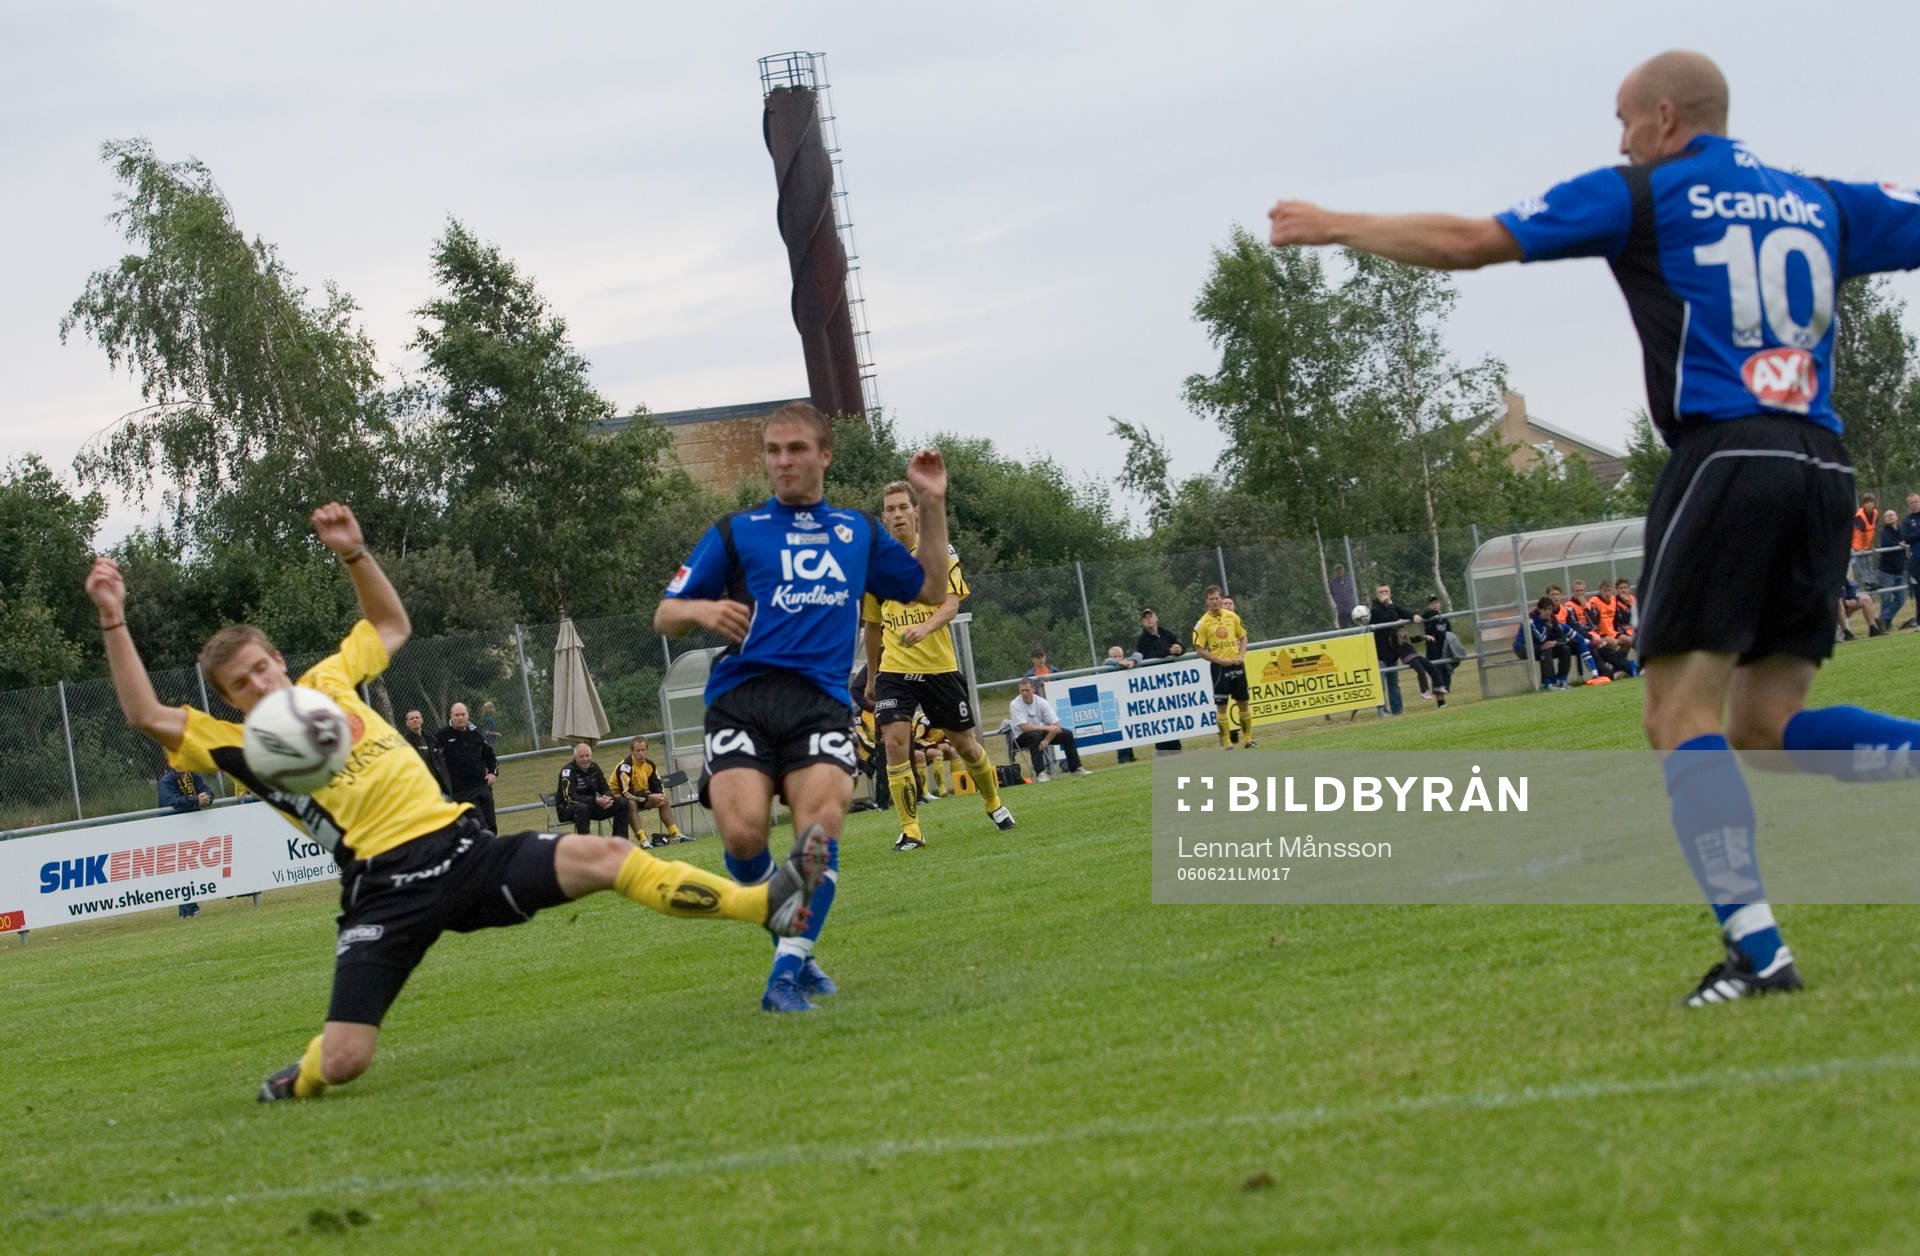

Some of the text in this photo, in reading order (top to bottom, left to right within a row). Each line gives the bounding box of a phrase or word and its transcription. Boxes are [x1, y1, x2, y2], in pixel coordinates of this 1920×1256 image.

[1688, 184, 1825, 229] Scandic
[1693, 224, 1835, 349] 10
[795, 511, 815, 521] ICA
[781, 549, 847, 582] ICA
[1128, 668, 1200, 694] HALMSTAD
[959, 701, 968, 717] 6
[1074, 708, 1100, 722] HMV
[1126, 690, 1209, 717] MEKANISKA
[1252, 688, 1372, 715] PUB BAR DANS DISCO
[1125, 714, 1195, 740] VERKSTAD
[1200, 711, 1217, 728] AB
[704, 728, 756, 763] ICA
[287, 837, 326, 861] Kra
[272, 871, 285, 883] Vi
[68, 881, 217, 916] www.shkenergi.se
